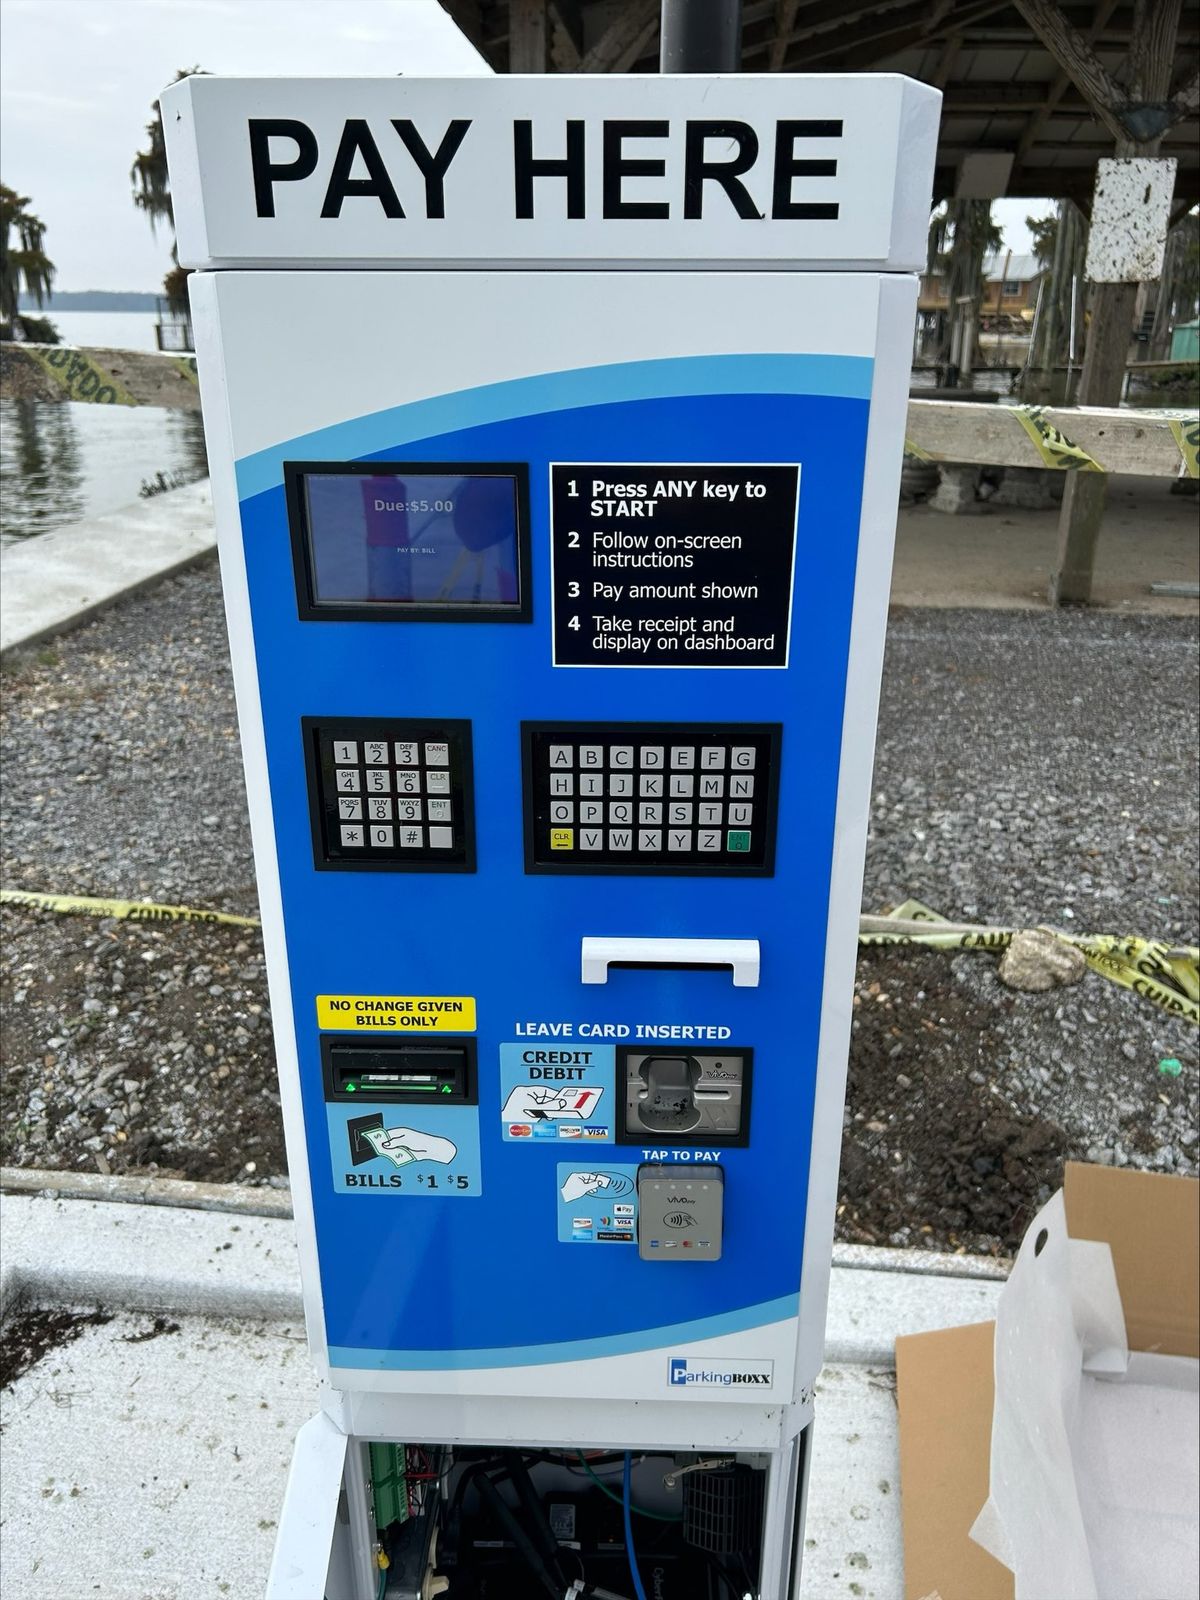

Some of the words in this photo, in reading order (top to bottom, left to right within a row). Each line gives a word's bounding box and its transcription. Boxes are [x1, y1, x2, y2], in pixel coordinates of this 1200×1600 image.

[248, 119, 473, 219] PAY
[513, 119, 843, 220] HERE
[567, 480, 579, 497] 1
[592, 480, 647, 498] Press
[652, 480, 697, 497] ANY
[703, 480, 739, 501] key
[745, 481, 767, 498] to
[374, 499, 454, 513] Due:$5.00
[590, 500, 658, 517] START
[567, 532, 580, 548] 2
[592, 531, 648, 549] Follow
[654, 535, 742, 549] on-screen
[592, 551, 694, 567] instructions
[567, 581, 580, 597] 3
[592, 582, 623, 601] Pay
[629, 584, 696, 598] amount
[701, 582, 758, 598] shown
[567, 616, 581, 631] 4
[592, 616, 632, 631] Take
[638, 616, 697, 635] receipt
[702, 616, 735, 632] and
[592, 634, 651, 653] display
[657, 637, 678, 650] on
[684, 634, 775, 650] dashboard
[342, 747, 351, 760] 1
[372, 750, 383, 763] 2
[402, 750, 412, 763] 3
[555, 750, 568, 764] A
[586, 751, 598, 764] B
[615, 751, 628, 765] C
[645, 752, 658, 765] D
[677, 752, 688, 765] E
[708, 752, 719, 766] F
[736, 752, 750, 766] G
[343, 778, 354, 791] 4
[374, 778, 384, 791] 5
[404, 779, 414, 792] 6
[556, 779, 568, 792] H
[588, 779, 595, 793] I
[617, 779, 625, 793] J
[646, 780, 657, 793] K
[677, 780, 686, 793] L
[705, 780, 718, 794] M
[736, 780, 748, 794] N
[345, 805, 355, 818] 7
[376, 806, 386, 819] 8
[405, 806, 415, 819] 9
[587, 806, 597, 820] P
[614, 805, 628, 822] Q
[645, 807, 657, 820] R
[675, 807, 686, 821] S
[705, 807, 717, 821] T
[734, 808, 747, 821] U
[377, 830, 387, 842] 0
[406, 831, 417, 843] #
[585, 833, 598, 846] V
[612, 834, 630, 847] W
[645, 834, 657, 847] X
[675, 834, 686, 847] Y
[704, 834, 715, 848] Z
[330, 1000, 350, 1011] NO
[355, 1001, 413, 1012] CHANGE
[417, 1001, 463, 1012] GIVEN
[356, 1015, 396, 1026] BILLS
[400, 1016, 438, 1027] ONLY
[515, 1022, 573, 1036] LEAVE
[578, 1023, 630, 1037] CARD
[635, 1024, 731, 1039] INSERTED
[522, 1050, 593, 1064] CREDIT
[529, 1067, 586, 1080] DEBIT
[642, 1150, 668, 1160] TAP
[672, 1151, 690, 1161] TO
[694, 1151, 721, 1161] PAY
[345, 1174, 402, 1188] BILLS
